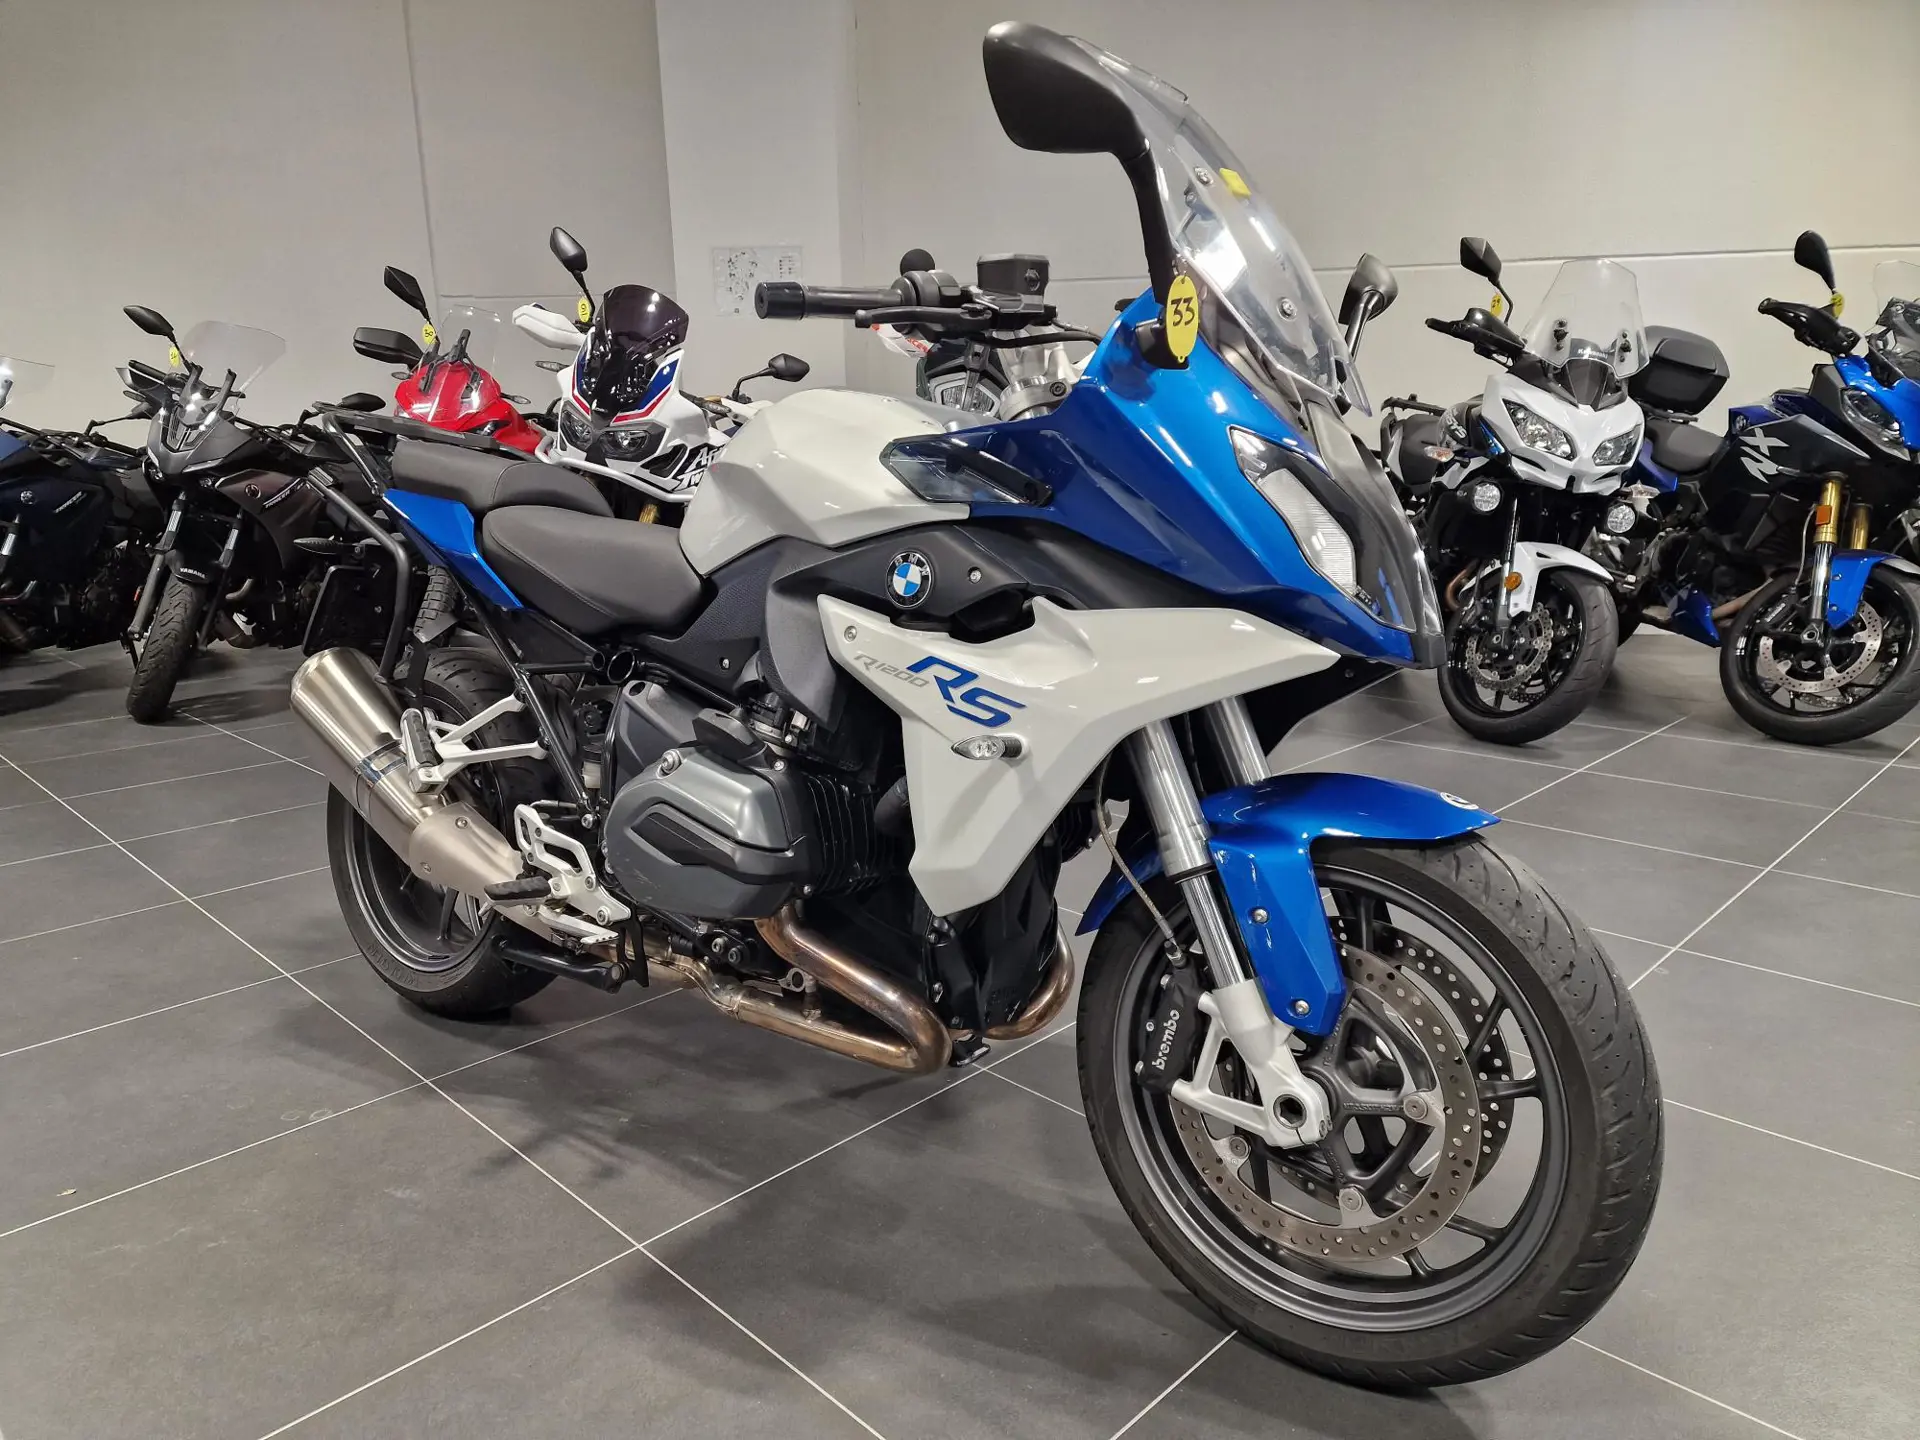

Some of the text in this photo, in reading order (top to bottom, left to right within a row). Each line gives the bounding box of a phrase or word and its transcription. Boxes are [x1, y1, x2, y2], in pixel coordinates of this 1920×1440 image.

[1170, 296, 1195, 327] 33
[180, 567, 206, 579] YAMAHA
[894, 552, 930, 577] BMW
[853, 653, 1027, 728] R1200 RS
[1151, 1009, 1180, 1071] brembo
